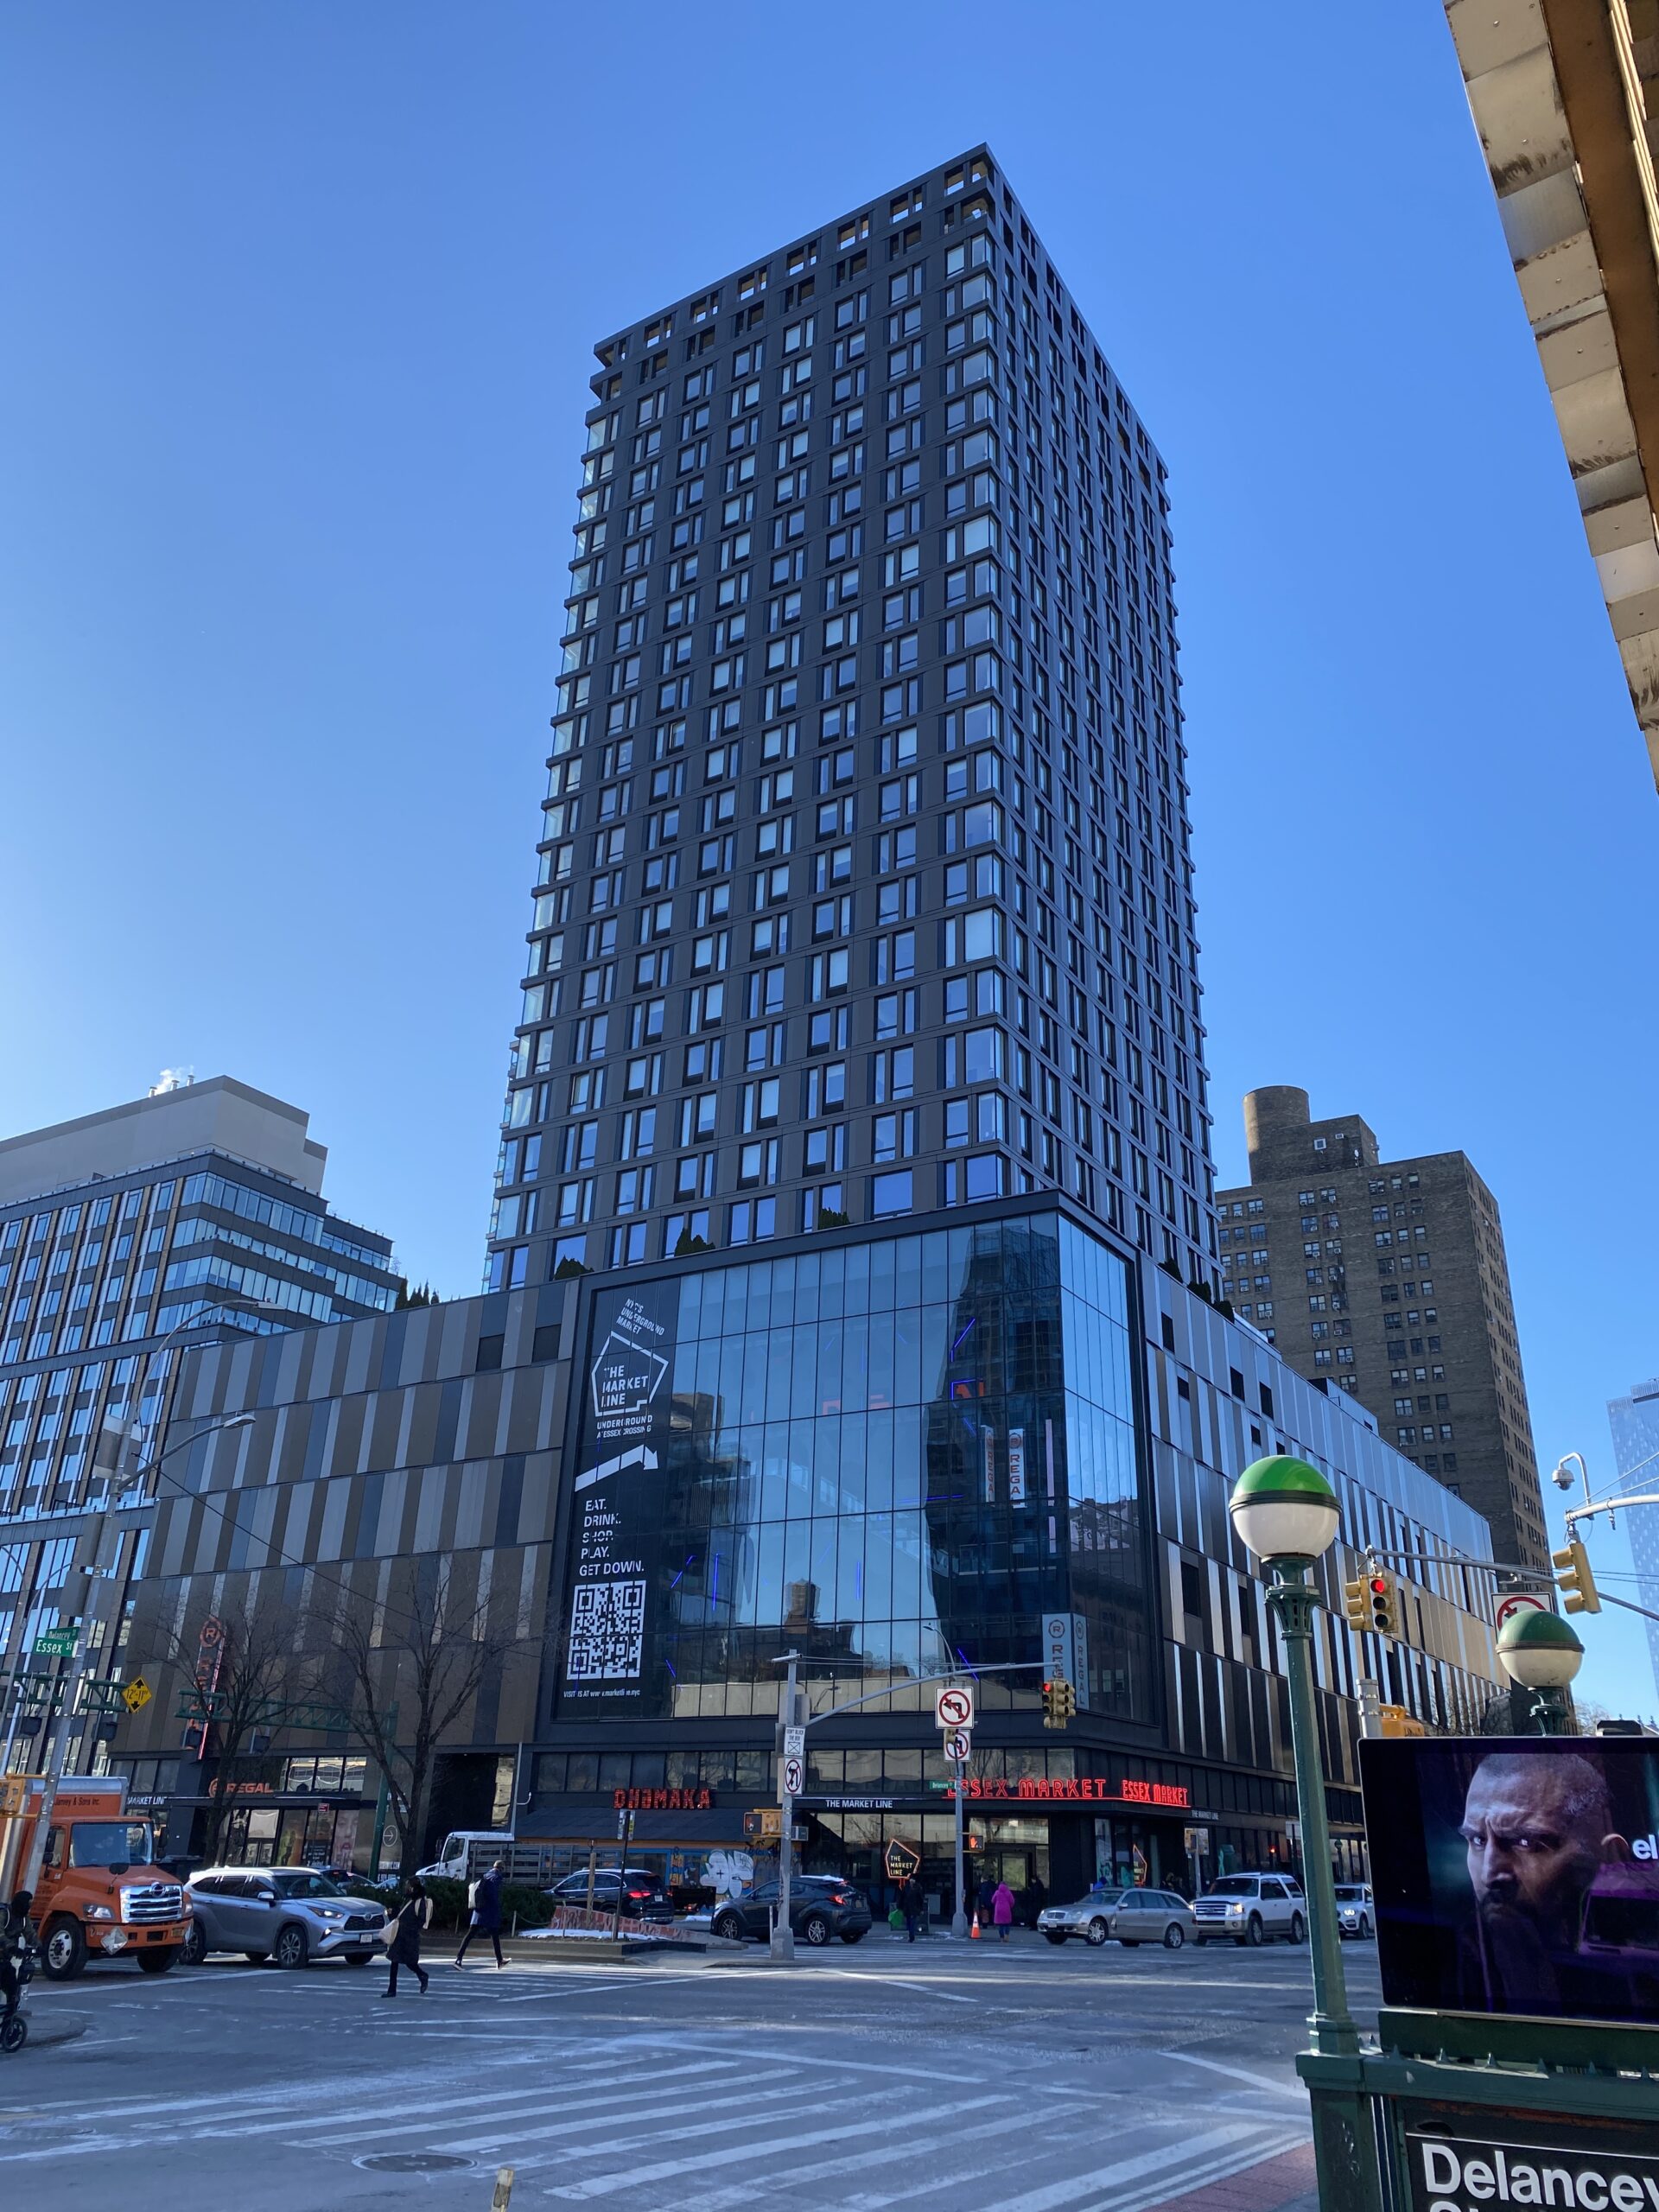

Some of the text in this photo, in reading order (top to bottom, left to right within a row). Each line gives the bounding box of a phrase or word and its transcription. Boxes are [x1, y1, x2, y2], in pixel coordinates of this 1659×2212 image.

[616, 1315, 642, 1334] MARKET
[620, 1307, 664, 1336] UNDERGROUND
[602, 1376, 648, 1393] MARKET
[601, 1393, 626, 1408] LINE
[596, 1414, 653, 1429] UNDERGROUND
[603, 1428, 621, 1439] ESSEX
[585, 1498, 607, 1511] EAT.
[584, 1513, 621, 1527] DRINK.
[581, 1546, 610, 1559] PLAY.
[580, 1560, 645, 1576] GET DOWN.
[36, 1639, 73, 1654] Essex St
[226, 1783, 274, 1794] REGAL
[948, 1777, 1106, 1798] ESSEX MARKET
[1122, 1780, 1188, 1805] ESSEX MARKET
[127, 1796, 152, 1805] MARKET
[875, 1800, 893, 1808] LINE
